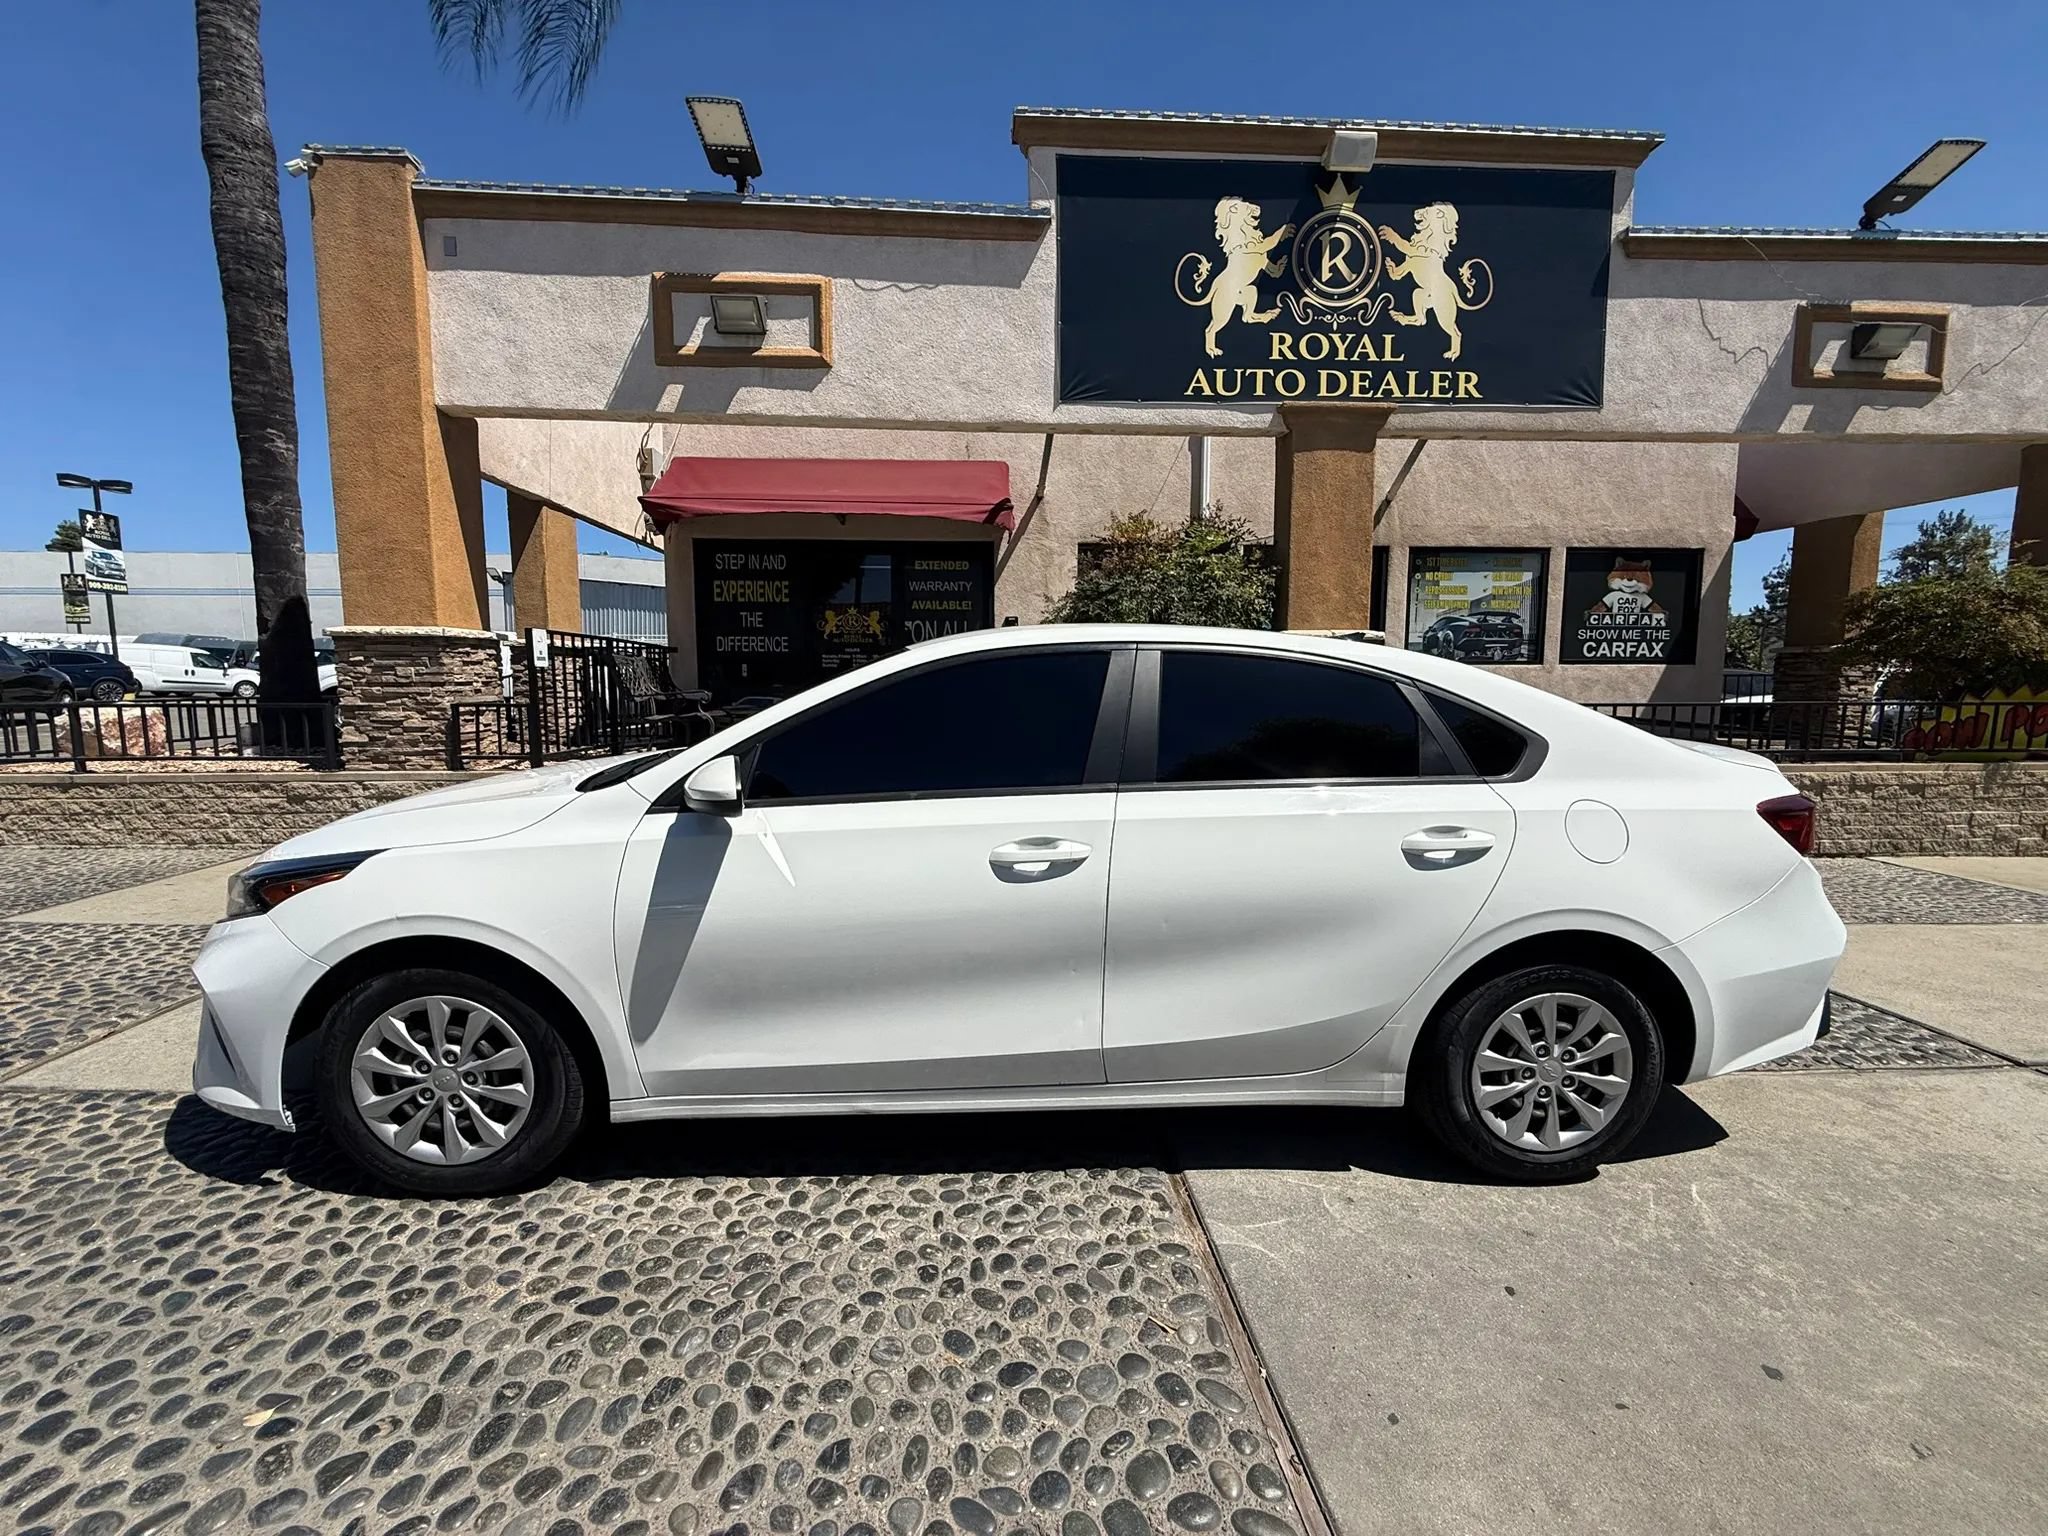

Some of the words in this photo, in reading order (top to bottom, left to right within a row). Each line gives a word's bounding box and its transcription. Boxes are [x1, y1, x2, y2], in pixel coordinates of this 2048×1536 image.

[1269, 331, 1405, 363] ROYAL
[1184, 367, 1307, 398] AUTO
[1316, 368, 1483, 399] DEALER
[715, 553, 745, 570] STEP
[748, 553, 760, 569] IN
[762, 553, 787, 570] AND
[914, 560, 969, 570] EXTENDED
[713, 580, 790, 602] EXPERIENCE
[909, 581, 973, 592] WARRANTY
[911, 600, 972, 611] AVAILABLE!
[1617, 597, 1638, 606] CAR
[740, 611, 764, 628] THE
[1589, 614, 1664, 626] CARFAX
[1577, 629, 1619, 640] SHOW
[1622, 629, 1641, 640] ME
[1645, 629, 1671, 640] THE
[716, 636, 789, 652] DIFFERENCE
[1582, 641, 1665, 658] CARFAX
